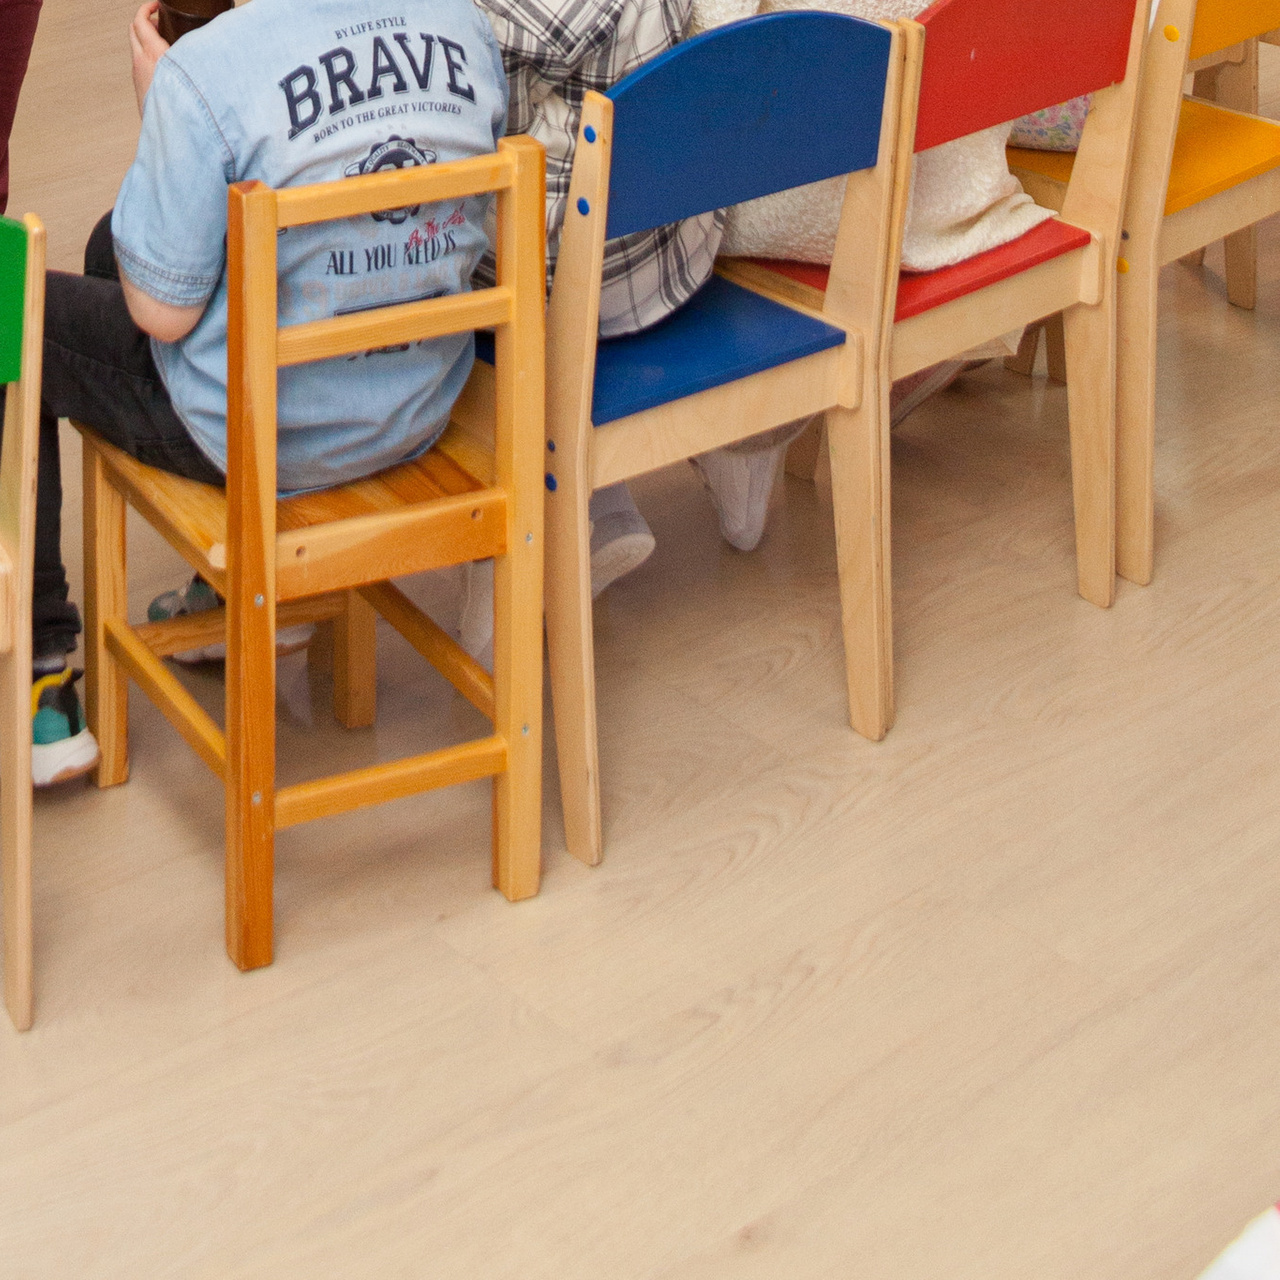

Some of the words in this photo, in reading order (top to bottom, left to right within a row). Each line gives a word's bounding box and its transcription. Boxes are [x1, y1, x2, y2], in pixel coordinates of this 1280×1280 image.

[335, 27, 349, 40] BY
[351, 21, 374, 36] LIFE
[375, 16, 407, 29] STYLE
[280, 32, 477, 141] BRAVE
[313, 122, 339, 143] BORN
[341, 115, 354, 130] TO
[355, 110, 376, 124] THE
[378, 103, 409, 119] GREAT
[411, 101, 462, 115] VICTORIES
[326, 250, 358, 275] ALL
[364, 242, 397, 272] YOU
[403, 236, 441, 265] NEED
[443, 229, 456, 255] IS
